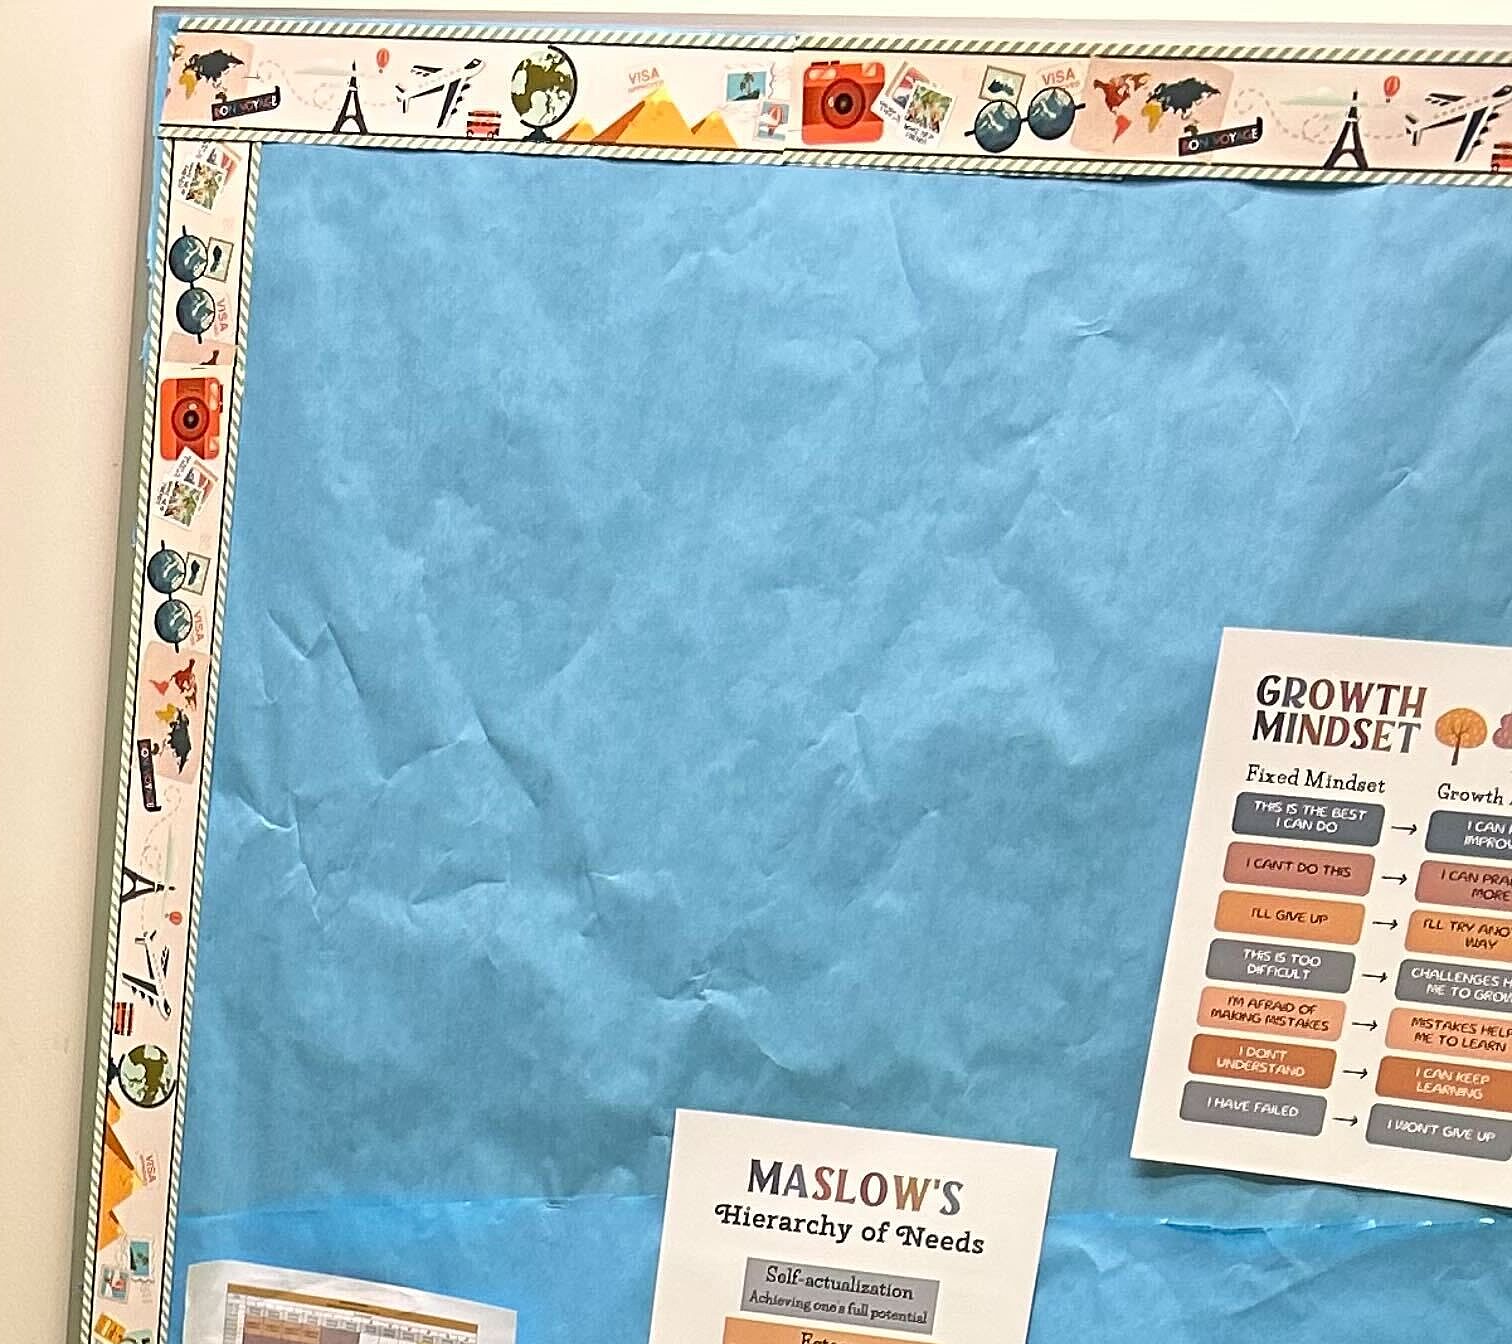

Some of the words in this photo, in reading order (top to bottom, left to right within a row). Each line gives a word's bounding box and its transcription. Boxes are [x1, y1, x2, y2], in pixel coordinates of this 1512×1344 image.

[1256, 674, 1428, 718] GROWTH
[1252, 709, 1422, 754] MINDSET
[1246, 763, 1300, 787] Fixed
[1304, 768, 1386, 794] Mindset
[1437, 782, 1504, 806] Growth
[1254, 800, 1283, 813] THIS
[1286, 803, 1298, 815] IS
[1303, 804, 1328, 818] THE
[1332, 807, 1368, 821] BEST
[1276, 817, 1281, 828] I
[1283, 818, 1313, 831] CAN
[1316, 820, 1338, 833] DO
[1467, 820, 1472, 831] I
[1475, 821, 1505, 834] CAN
[1246, 858, 1251, 868] I
[1297, 861, 1319, 875] DO
[1323, 864, 1352, 878] THIS
[1441, 869, 1446, 881] I
[1449, 870, 1479, 883] CAN
[1471, 888, 1511, 901] MORE
[1276, 909, 1308, 923] GIVE
[1310, 912, 1329, 925] UP
[1449, 920, 1476, 933] TRY
[1464, 937, 1499, 950] WAY
[1243, 948, 1271, 963] THIS
[1275, 951, 1286, 964] IS
[1291, 953, 1322, 967] TOO
[1247, 963, 1311, 981] DIFFICULT
[1410, 967, 1500, 988] CHALLENGES
[1426, 983, 1446, 996] ME
[1451, 986, 1472, 999] TO
[1247, 997, 1295, 1013] AFRAID
[1298, 1003, 1319, 1016] OF
[1210, 1008, 1261, 1025] MAKING
[1265, 1013, 1330, 1033] MISTAKES
[1410, 1017, 1479, 1035] MISTAKES
[1239, 1046, 1244, 1058] I
[1414, 1032, 1433, 1044] ME
[1438, 1034, 1459, 1047] TO
[1461, 1037, 1507, 1053] LEARN
[1216, 1057, 1306, 1078] UNDERSTAND
[1415, 1066, 1421, 1077] I
[1423, 1068, 1453, 1081] CAN
[1456, 1072, 1491, 1085] KEEP
[1416, 1081, 1484, 1100] LEARNING
[1207, 1096, 1212, 1108] I
[1214, 1097, 1250, 1112] HAVE
[1253, 1101, 1300, 1118] FAILED
[1387, 1119, 1392, 1129] I
[1442, 1125, 1474, 1141] GIVE
[1476, 1131, 1497, 1143] UP
[747, 1158, 964, 1216] MASLOW'S
[714, 1202, 853, 1244] Hierarchy
[861, 1220, 891, 1244] of
[895, 1224, 985, 1255] Needs
[765, 1265, 914, 1301] Self-actualization
[749, 1289, 812, 1313] Achieving
[847, 1301, 869, 1318] full
[870, 1307, 928, 1325] potential
